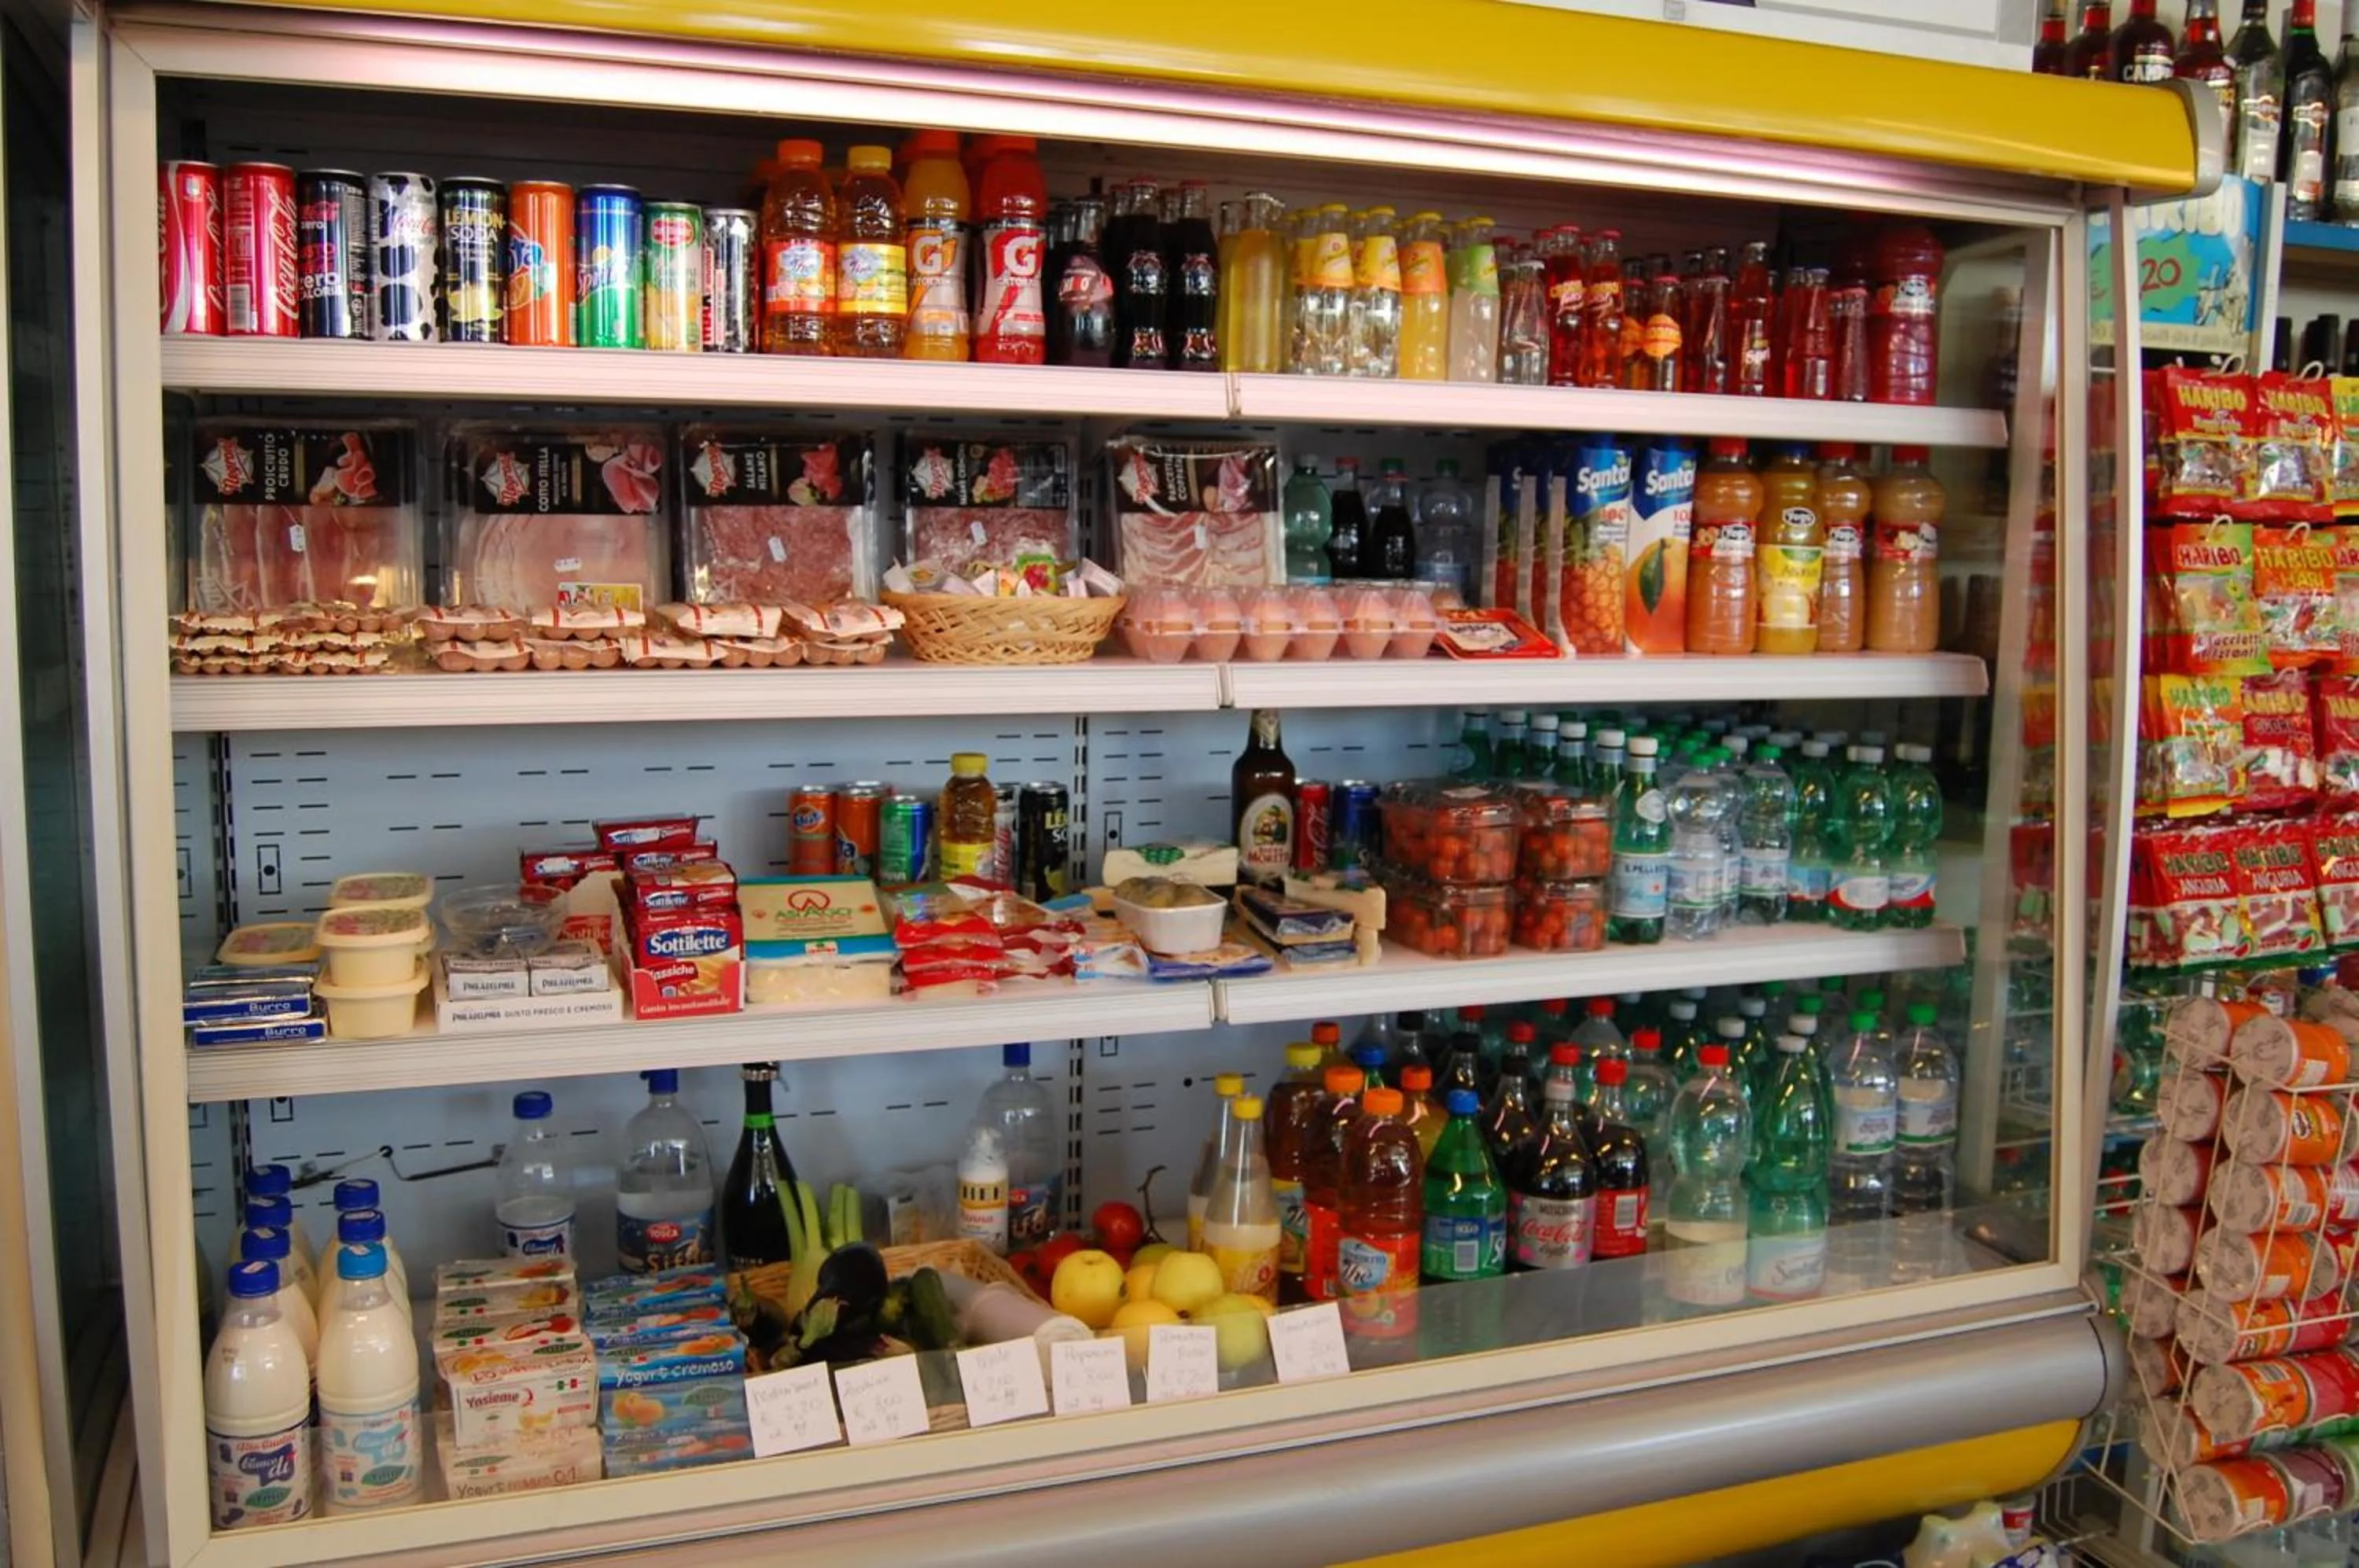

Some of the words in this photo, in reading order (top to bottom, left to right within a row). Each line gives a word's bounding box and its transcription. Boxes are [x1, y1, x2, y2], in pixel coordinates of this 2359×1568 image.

[450, 226, 499, 243] SODA
[915, 236, 944, 275] G
[1004, 236, 1037, 276] G
[300, 272, 337, 291] ero
[2139, 257, 2181, 292] 20
[2179, 384, 2247, 412] HARIBO
[278, 447, 289, 488] CRUDO
[538, 480, 549, 512] COTTO
[2177, 545, 2242, 567] HARIBO
[2257, 547, 2334, 571] HARIBO
[650, 931, 727, 955] Sottilette
[652, 965, 695, 981] assiche
[248, 1000, 291, 1013] Burro
[504, 1007, 531, 1018] GUSTO
[532, 1006, 565, 1017] FRESCO
[574, 1003, 613, 1014] CREMOSO
[264, 1025, 307, 1037] Burro
[1522, 1218, 1588, 1245] Coca-Cola
